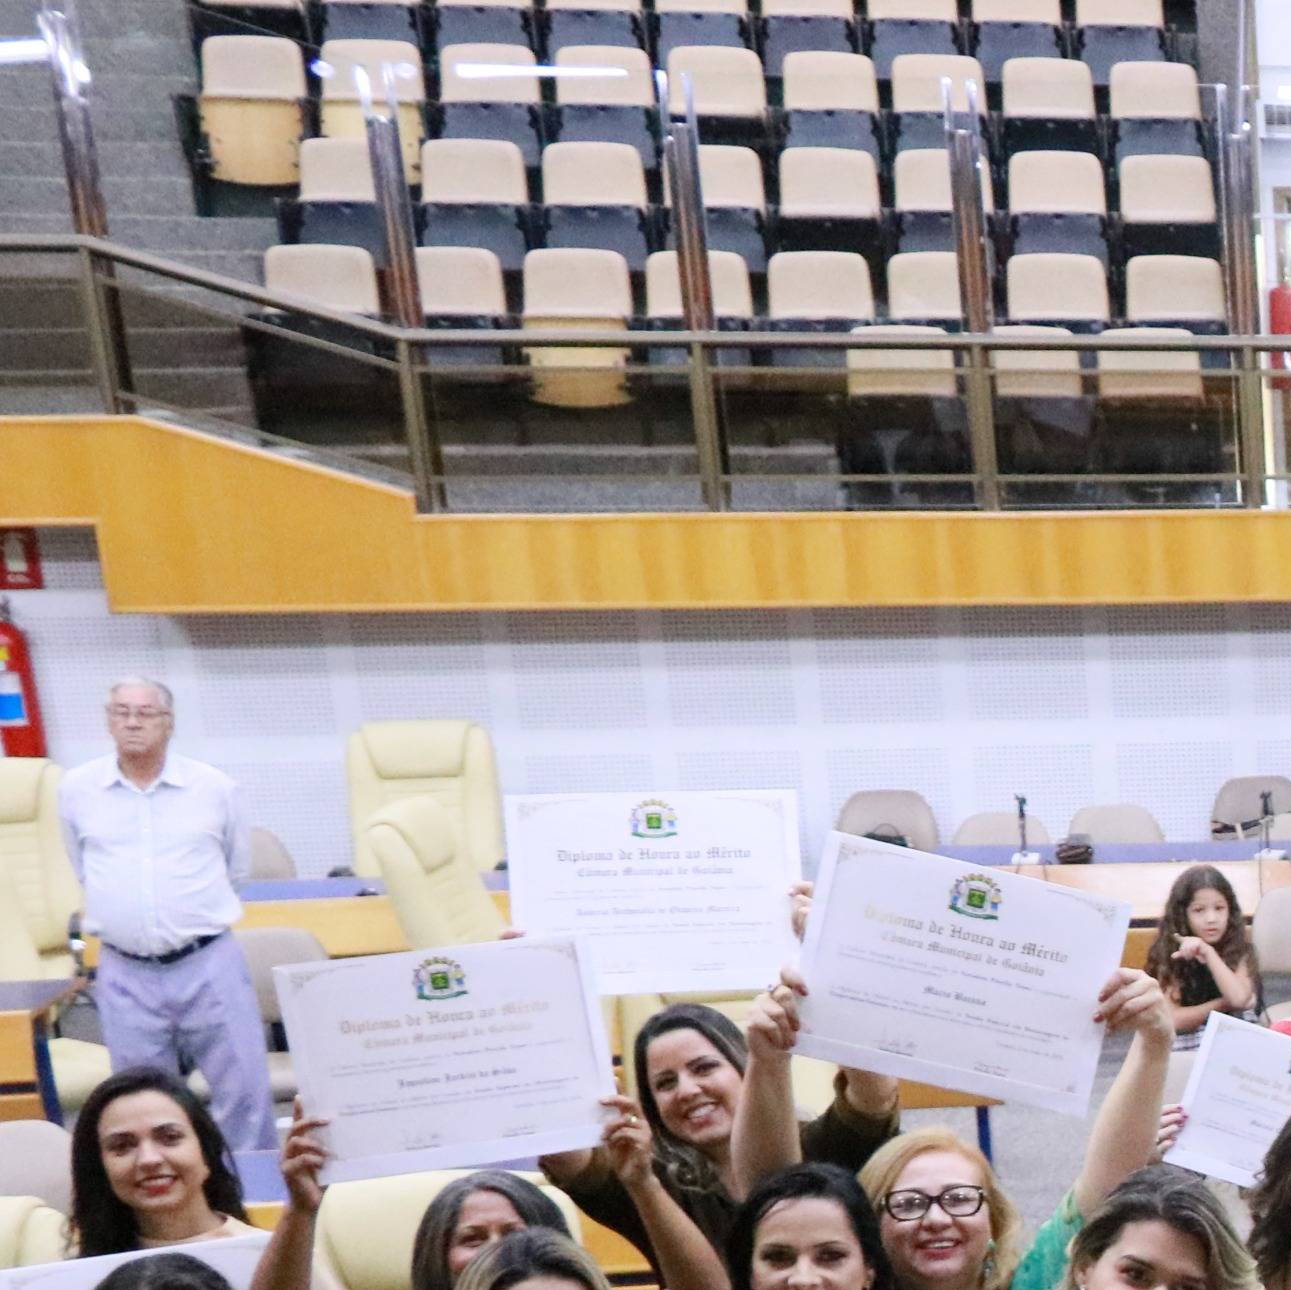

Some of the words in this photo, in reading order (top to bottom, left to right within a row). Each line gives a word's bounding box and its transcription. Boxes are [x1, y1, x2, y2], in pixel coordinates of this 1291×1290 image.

[556, 848, 614, 864] Diploma
[618, 848, 634, 861] de
[637, 847, 681, 860] Honra
[685, 850, 701, 859] ao
[705, 845, 751, 859] Mérito
[926, 939, 983, 964] Municipal
[985, 952, 998, 967] de
[928, 919, 945, 936] de
[948, 923, 994, 947] Honra
[999, 939, 1016, 952] ao
[1020, 939, 1069, 964] Mérito
[339, 1015, 401, 1037] Diploma
[404, 1011, 423, 1028] de
[427, 1008, 475, 1025] Honra
[479, 1007, 497, 1019] ao
